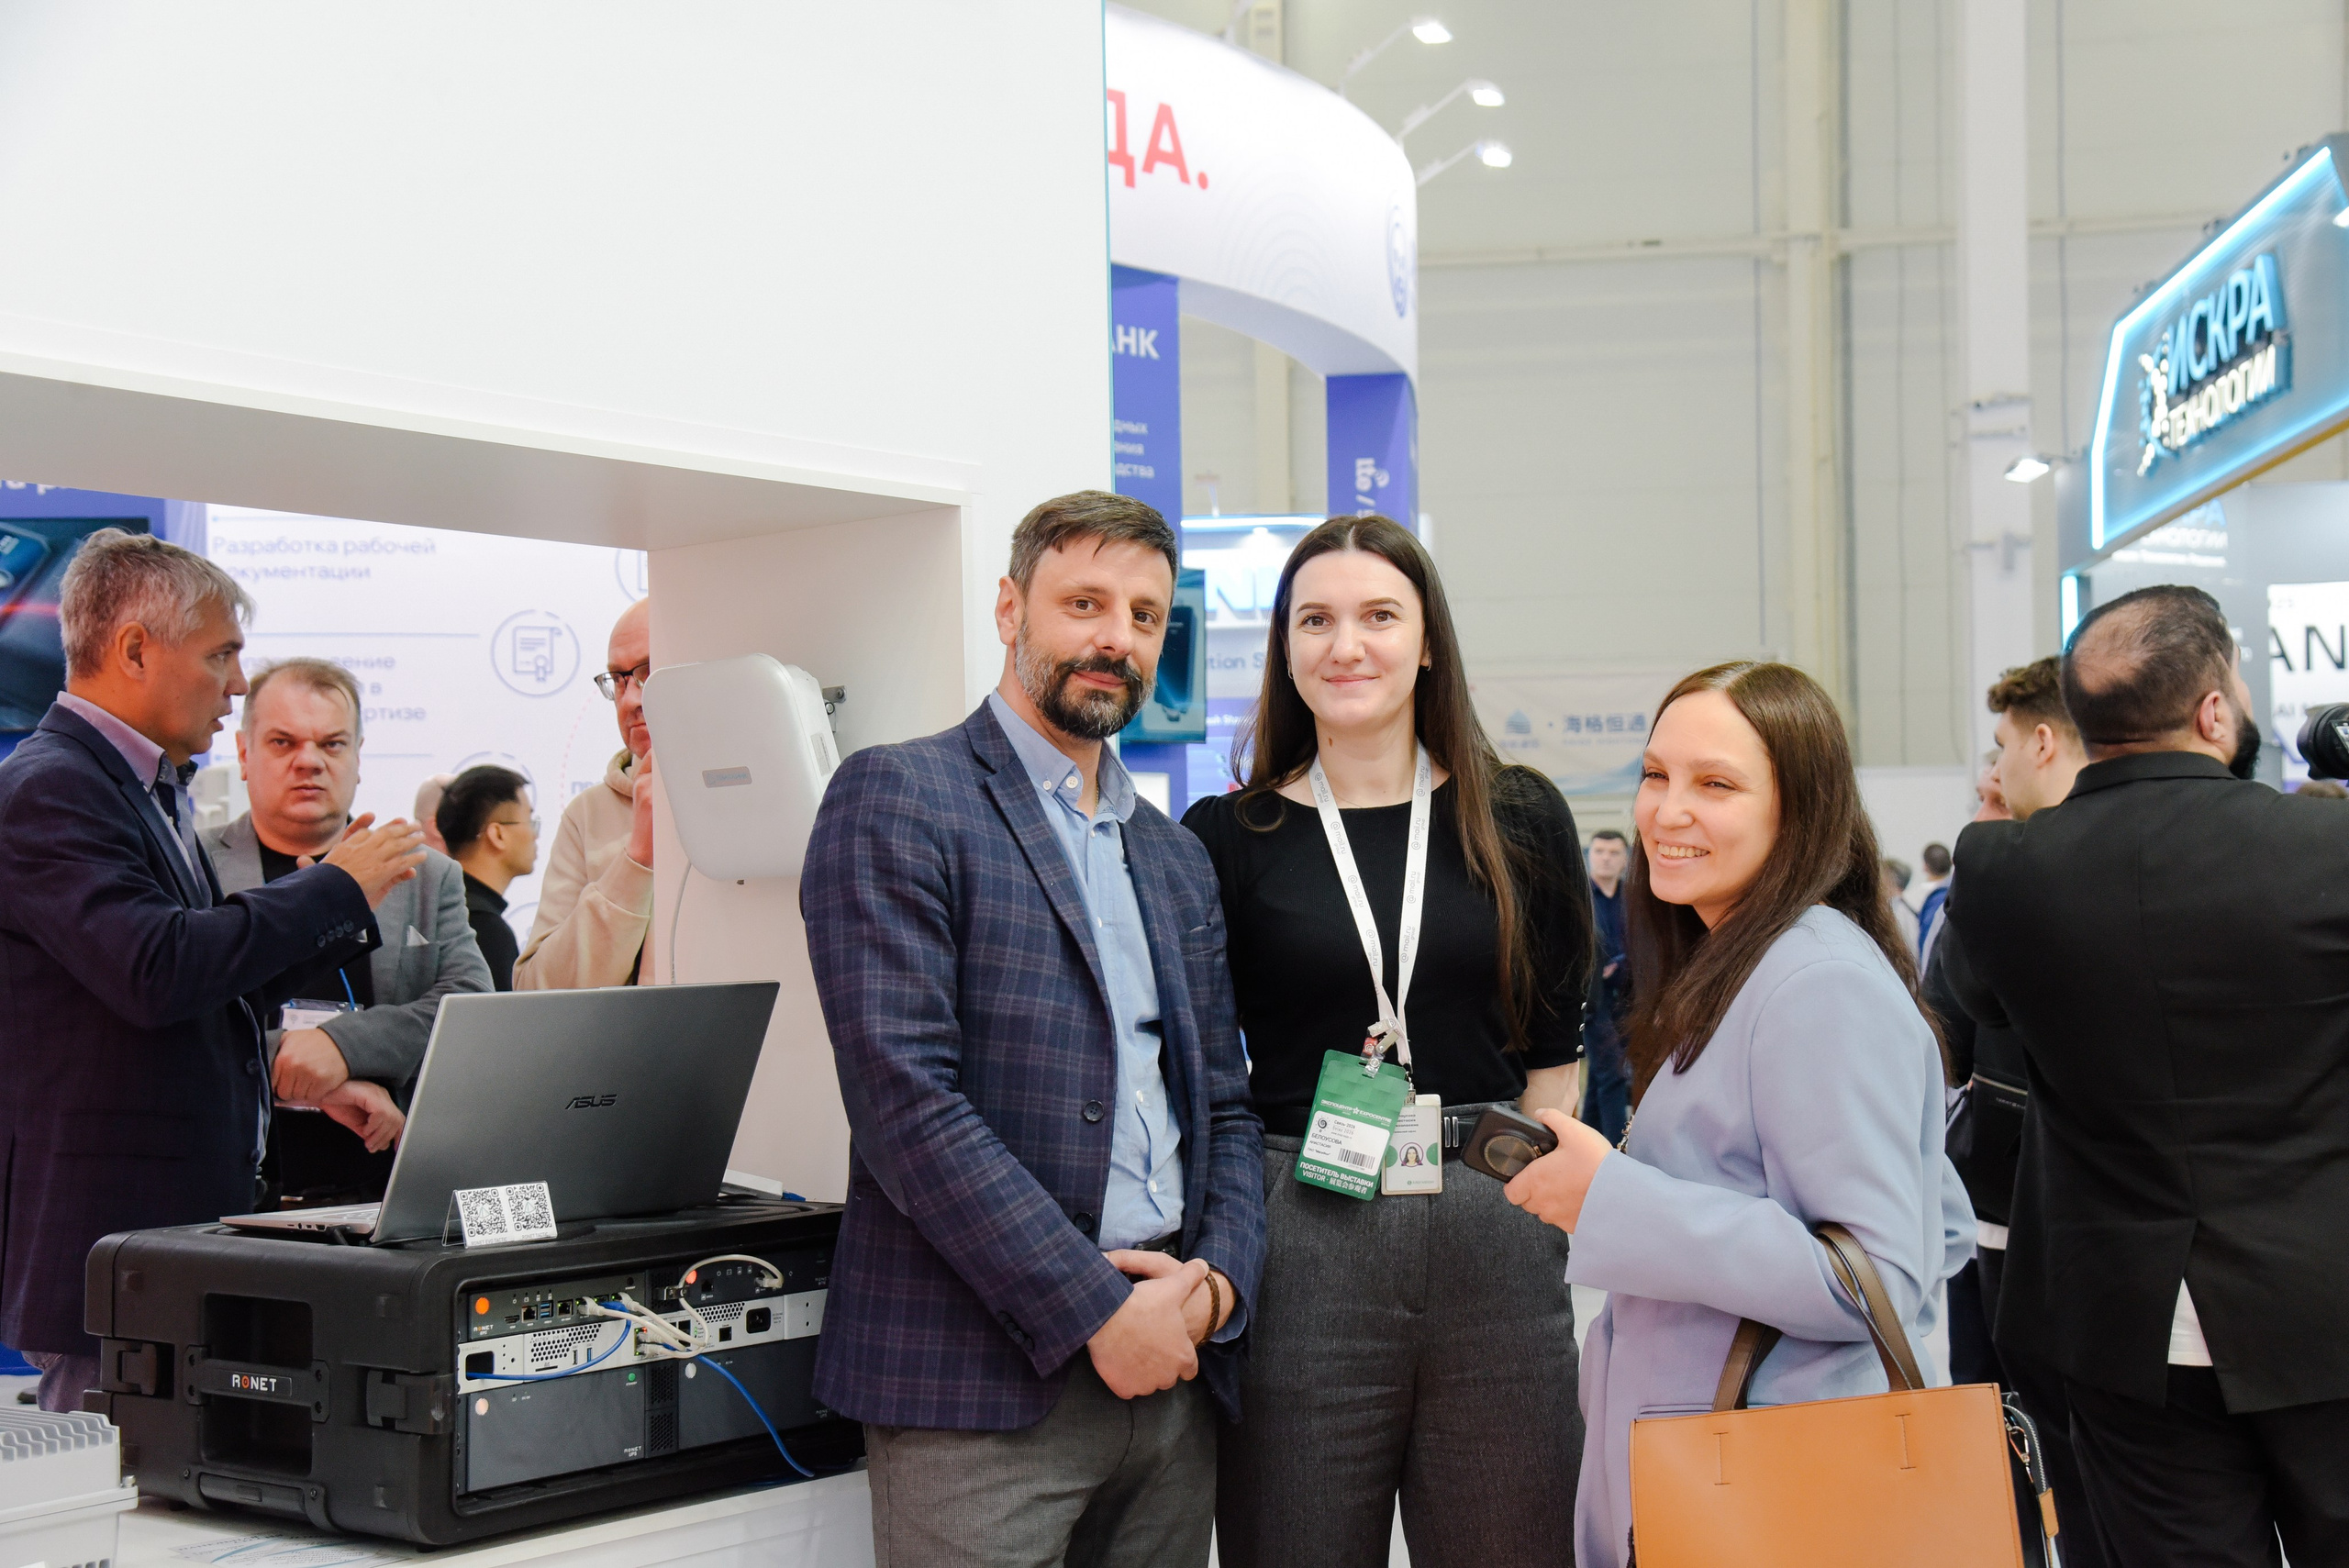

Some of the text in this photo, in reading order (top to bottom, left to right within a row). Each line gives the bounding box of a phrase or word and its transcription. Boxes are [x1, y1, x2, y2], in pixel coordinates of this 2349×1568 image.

[2166, 252, 2279, 398] ИСКРА
[1112, 323, 1161, 361] НК
[2167, 343, 2277, 450] ТЕХНОЛОГИИ
[212, 536, 436, 556] Разработка рабочей
[223, 565, 372, 584] окументации
[565, 1094, 618, 1110] ASUS
[1311, 1133, 1342, 1145] БЕЛОУСОВА
[1299, 1162, 1375, 1188] ПОСЕТИТЕЛЬ ВЫСТАВКИ
[1302, 1170, 1327, 1182] VISITOR
[232, 1373, 277, 1392] RONET
